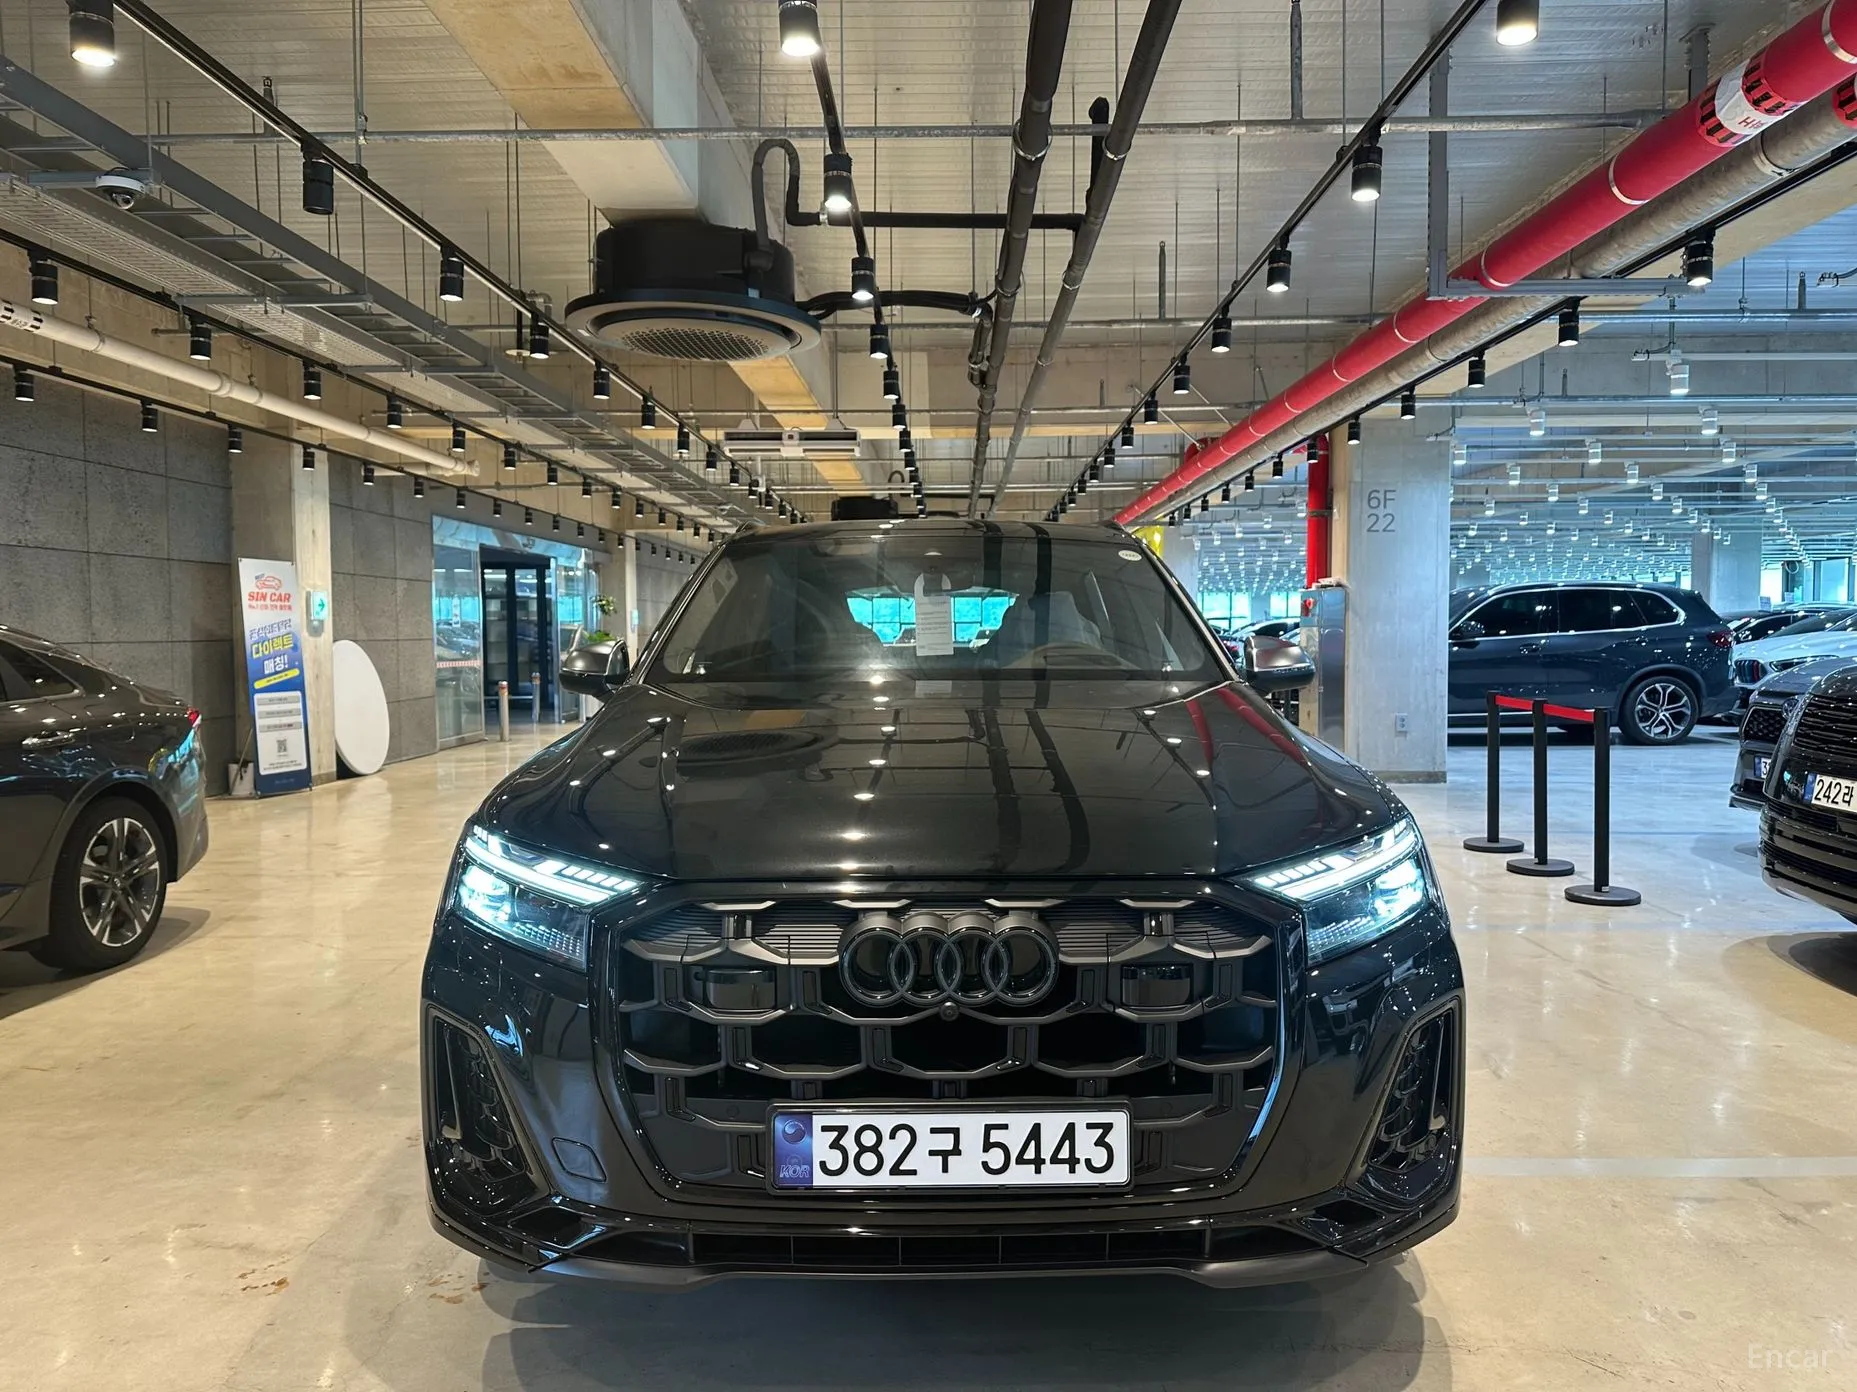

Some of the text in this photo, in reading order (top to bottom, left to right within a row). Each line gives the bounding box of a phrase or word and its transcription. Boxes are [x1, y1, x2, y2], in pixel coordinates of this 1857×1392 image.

[1367, 489, 1396, 509] 6F
[1366, 513, 1395, 532] 22
[248, 591, 291, 603] SIN CAR
[252, 634, 294, 659] 다이렉트
[263, 654, 288, 675] 매칭!
[1814, 778, 1854, 807] 242라
[819, 1122, 1114, 1176] 382구 5443
[780, 1164, 810, 1178] KOR
